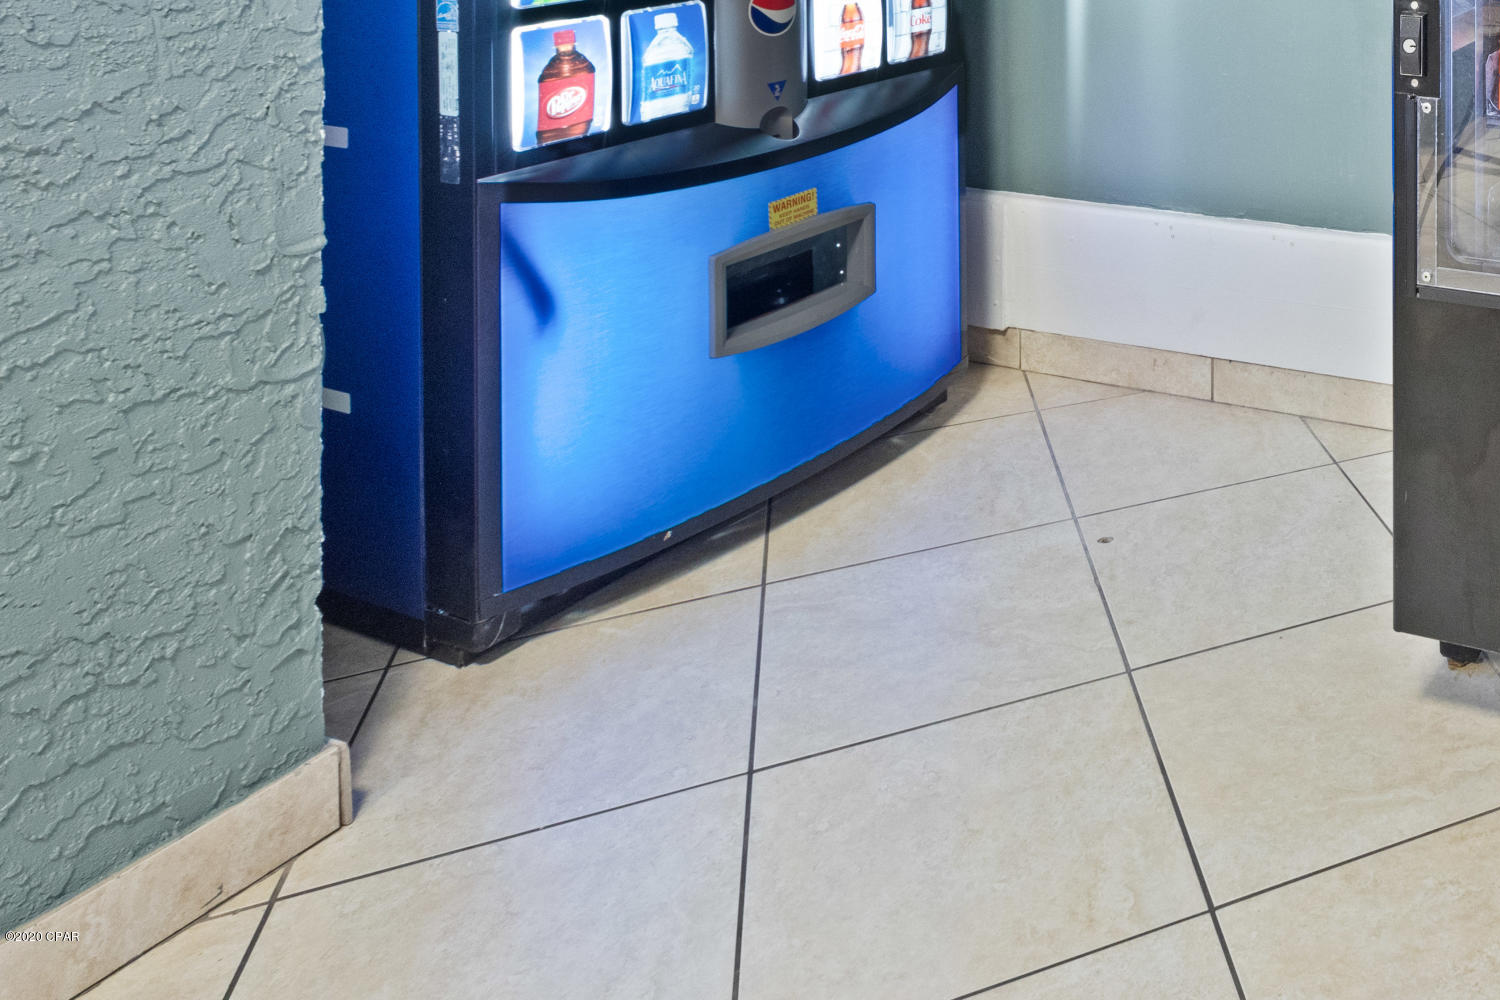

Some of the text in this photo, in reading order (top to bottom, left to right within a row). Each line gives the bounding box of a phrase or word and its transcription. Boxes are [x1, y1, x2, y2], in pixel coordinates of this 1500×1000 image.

[910, 12, 930, 27] Coke
[649, 71, 687, 91] AQUAFINA
[773, 192, 814, 213] WARNING!
